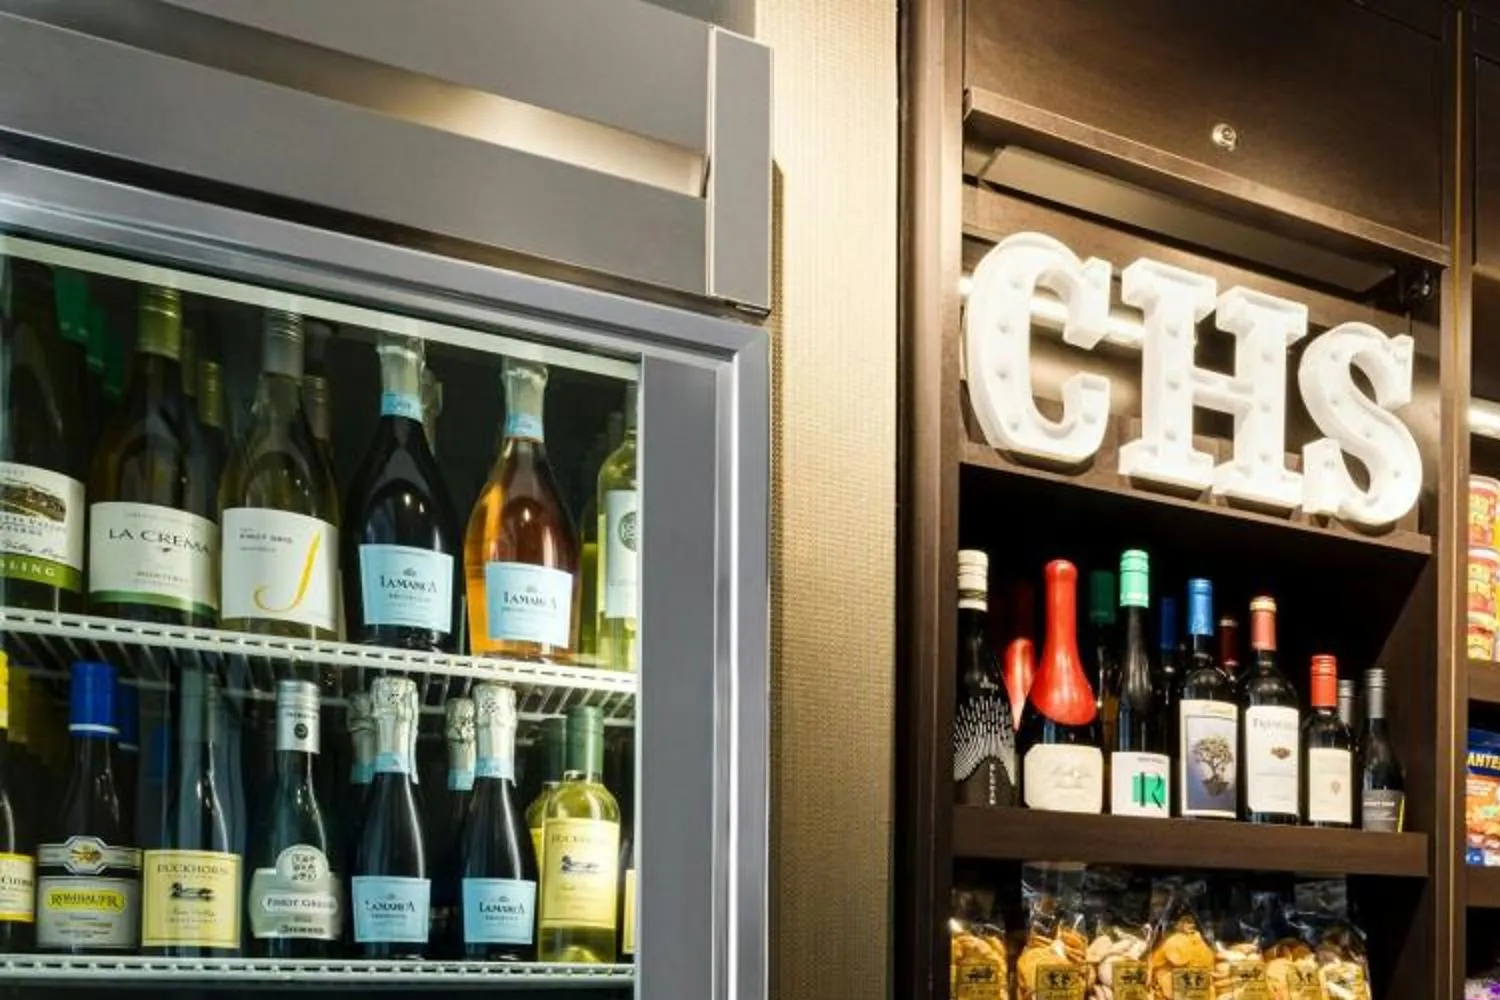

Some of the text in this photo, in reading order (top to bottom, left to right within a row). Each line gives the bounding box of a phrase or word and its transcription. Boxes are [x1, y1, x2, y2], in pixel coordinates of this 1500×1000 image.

[967, 231, 1423, 525] CHS
[108, 527, 211, 557] LA CREMA
